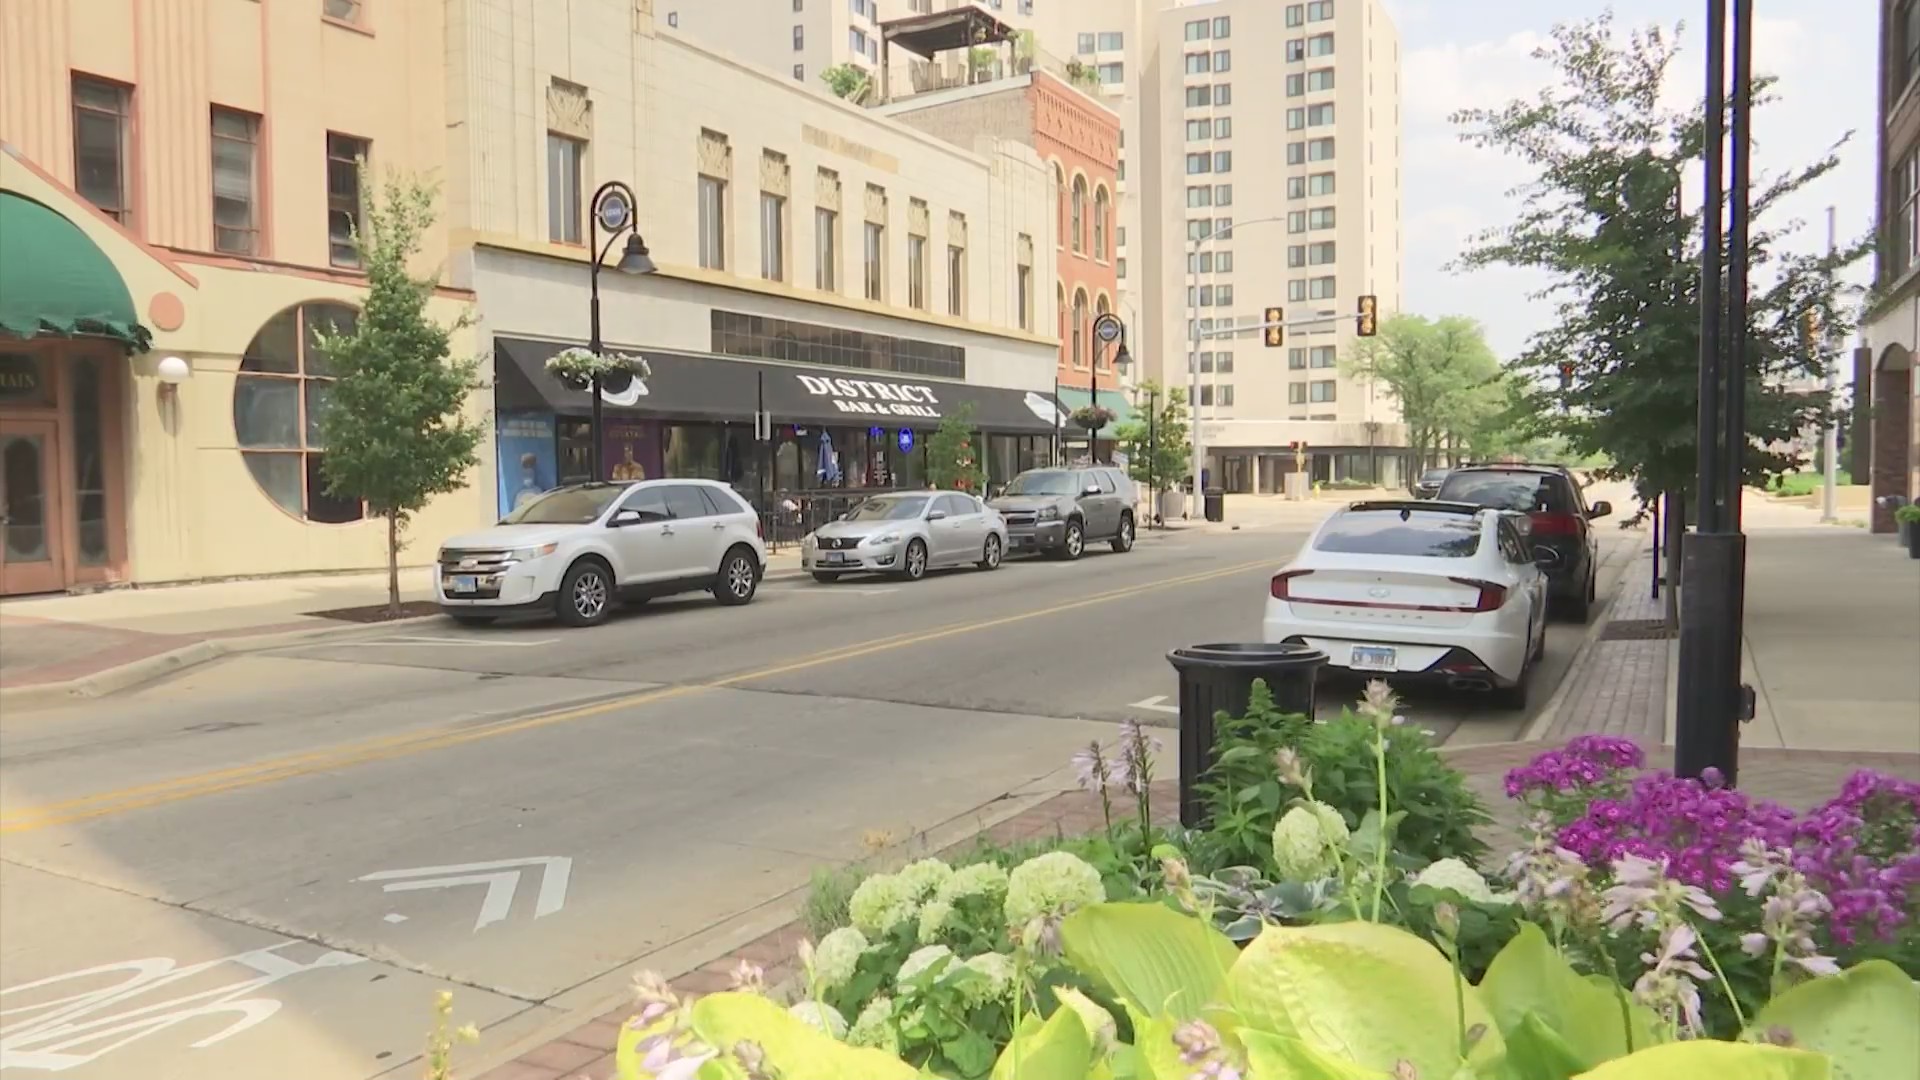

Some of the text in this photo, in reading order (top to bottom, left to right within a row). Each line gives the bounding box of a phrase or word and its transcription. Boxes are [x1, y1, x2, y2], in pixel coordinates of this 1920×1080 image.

[796, 374, 939, 403] DISTRICT
[832, 399, 942, 417] BAR & GRILL
